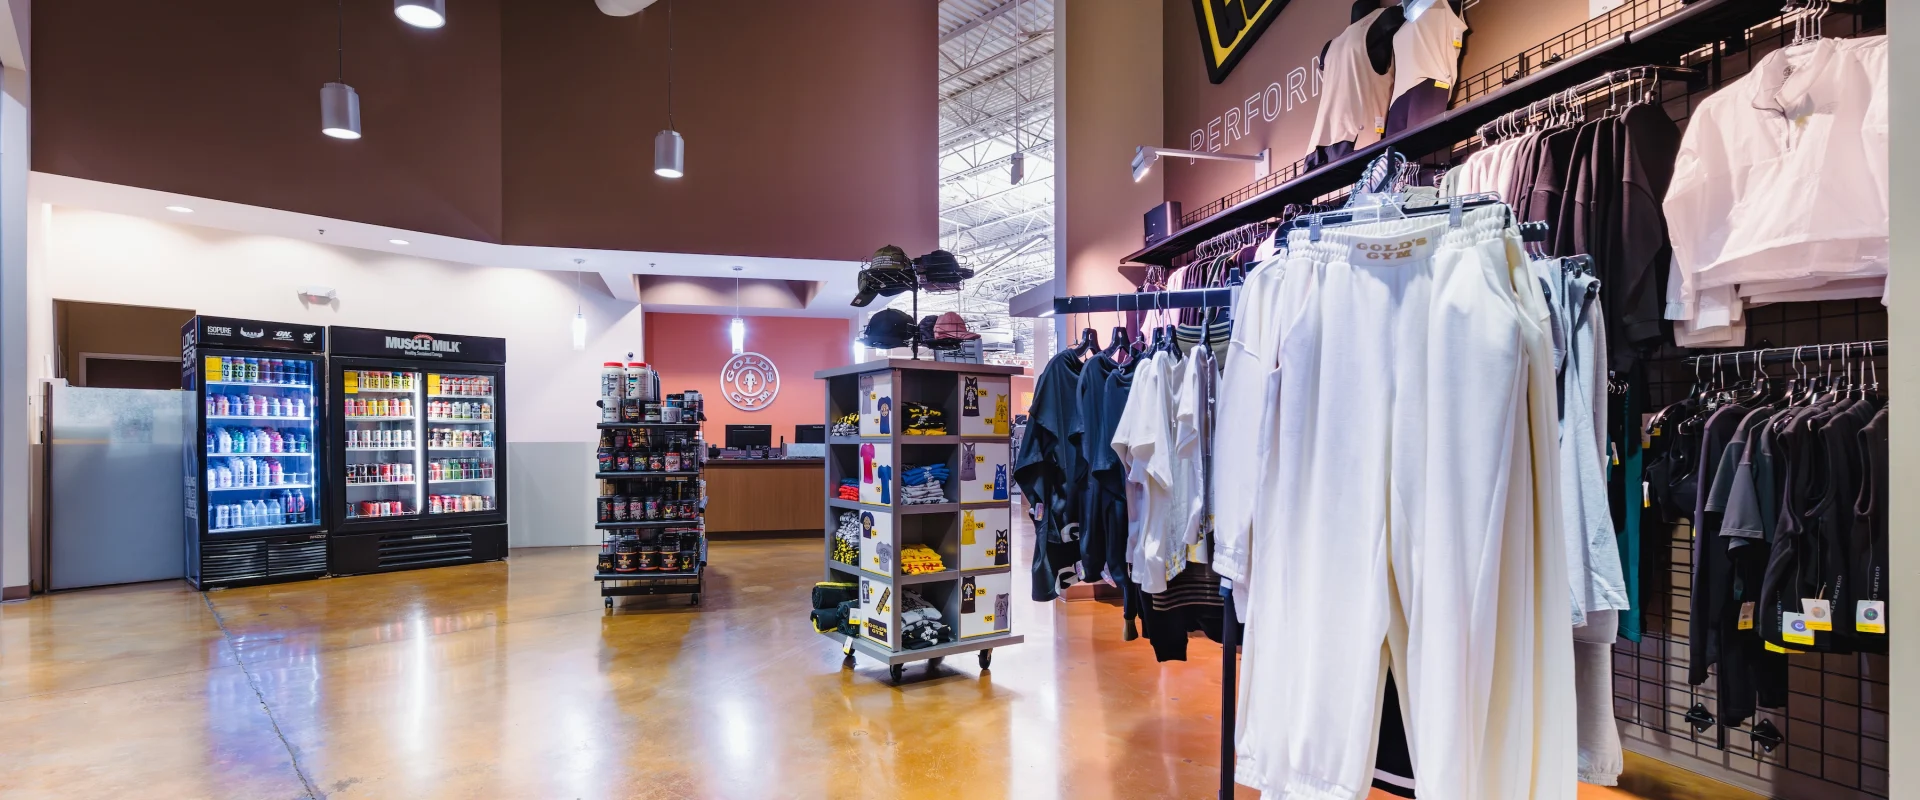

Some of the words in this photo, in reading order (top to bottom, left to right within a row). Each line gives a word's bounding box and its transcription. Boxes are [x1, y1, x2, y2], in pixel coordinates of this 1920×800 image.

[1356, 237, 1427, 252] GOLD'S
[1366, 249, 1412, 260] GYM
[207, 325, 232, 334] ISOPURE
[182, 328, 195, 350] LONE
[385, 336, 431, 351] MUSCLE
[432, 340, 460, 353] MILK
[726, 356, 775, 383] GOLD'S
[730, 389, 771, 407] GYM
